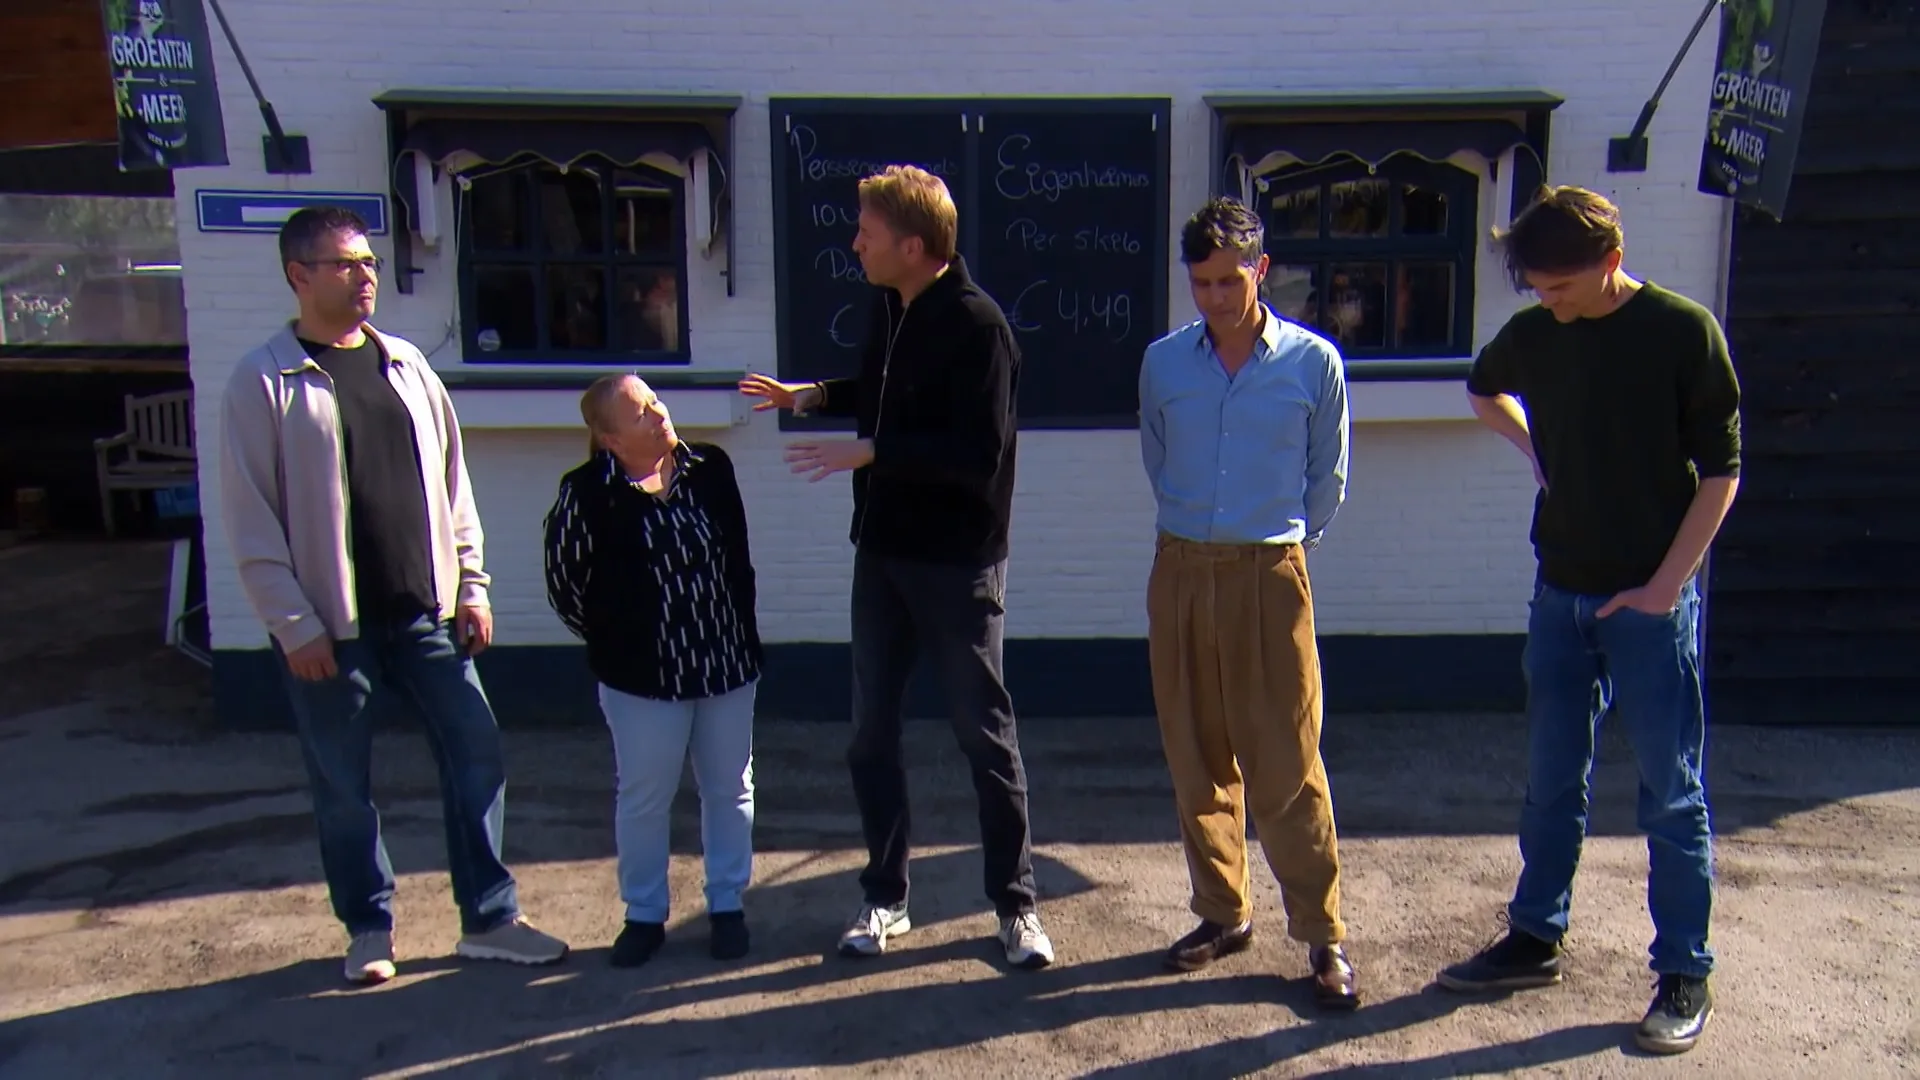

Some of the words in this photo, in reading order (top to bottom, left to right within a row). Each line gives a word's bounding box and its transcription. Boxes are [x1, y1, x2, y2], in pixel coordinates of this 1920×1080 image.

[112, 34, 193, 69] GROENTEN
[1713, 73, 1790, 118] GROENTEN
[812, 203, 837, 228] 10
[1005, 217, 1058, 252] Per
[1004, 279, 1049, 332] €
[1057, 287, 1132, 345] 4,49
